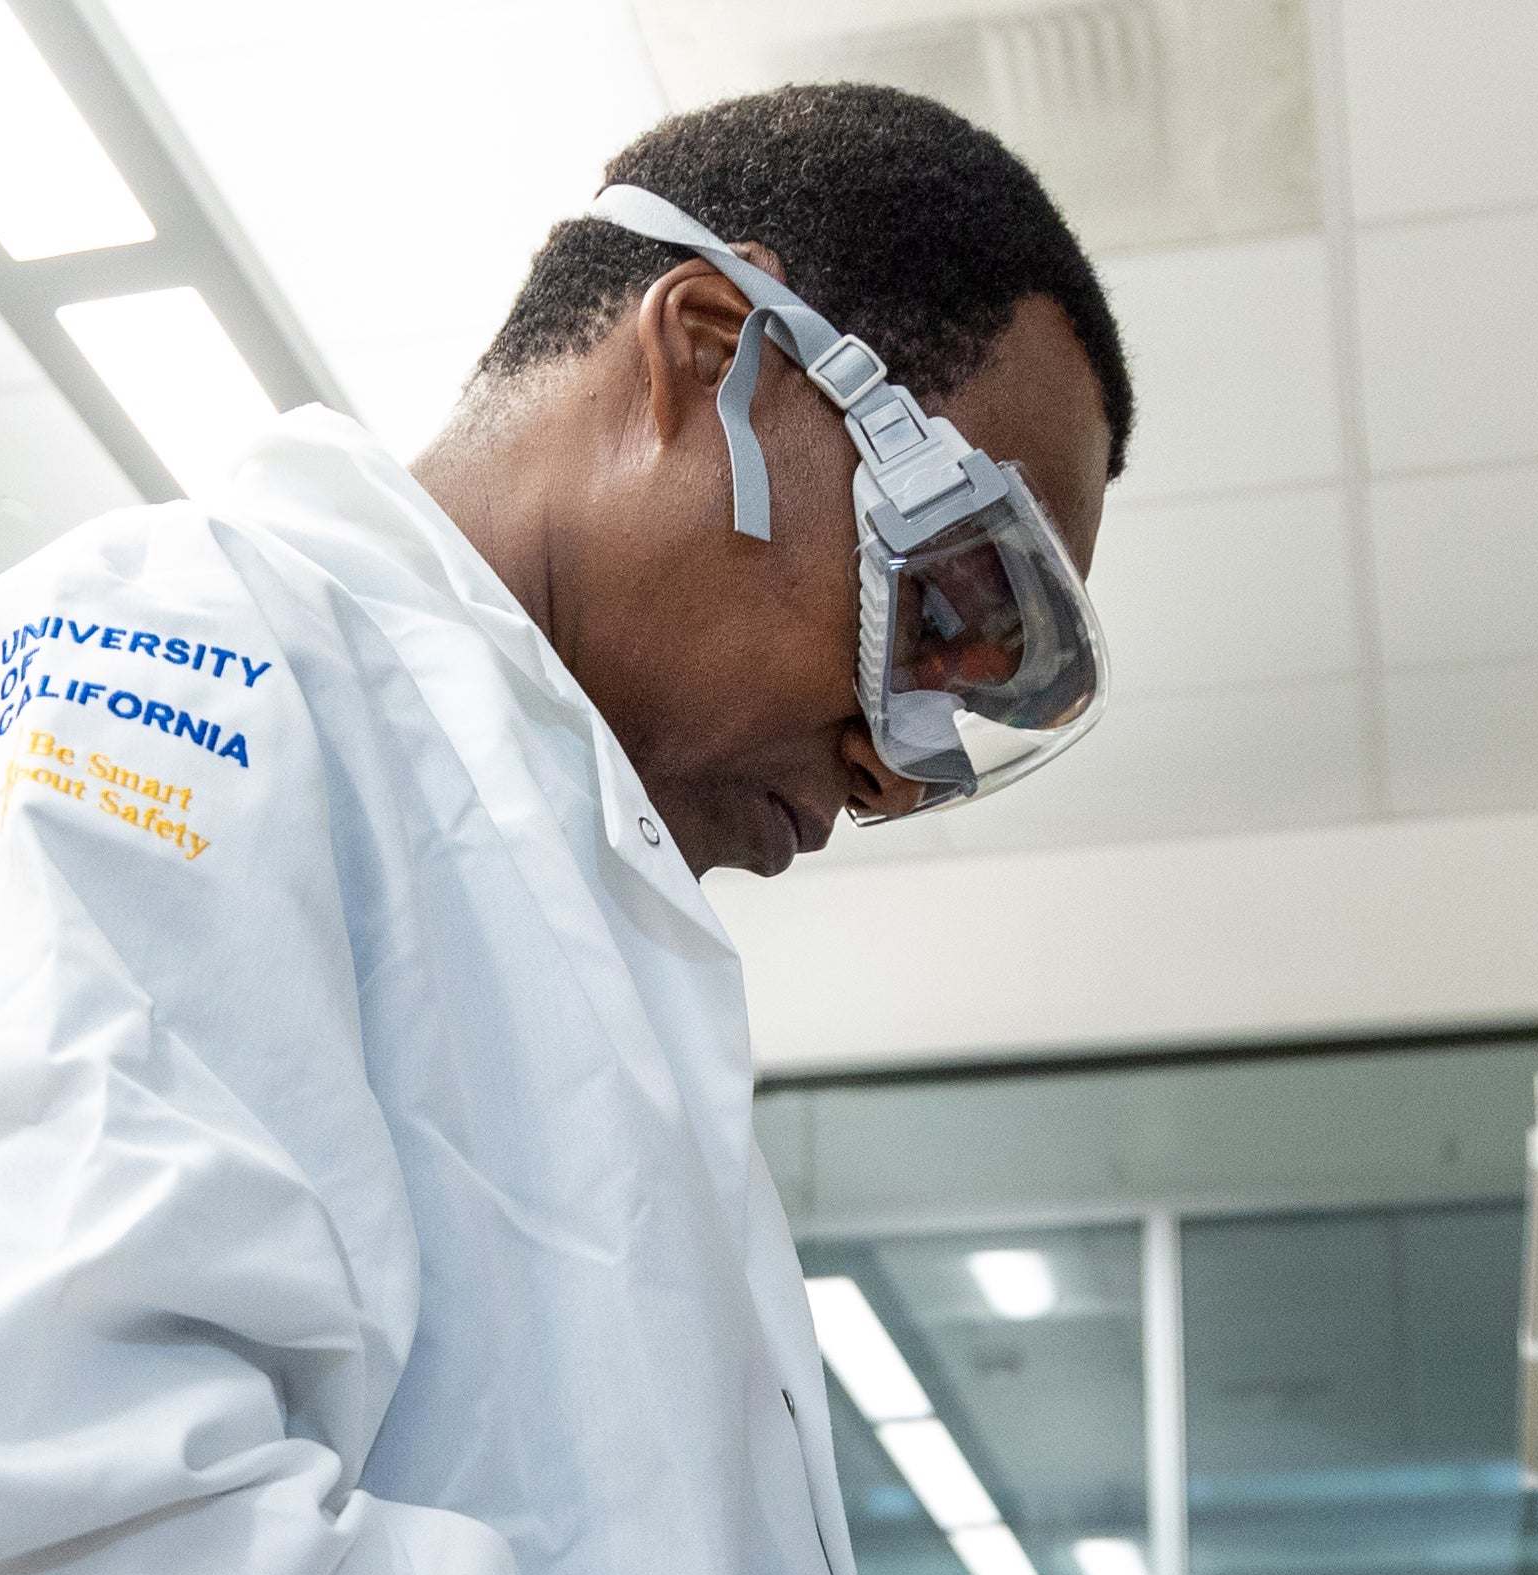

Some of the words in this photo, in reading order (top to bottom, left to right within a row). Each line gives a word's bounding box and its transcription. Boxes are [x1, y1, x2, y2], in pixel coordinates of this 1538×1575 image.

[0, 646, 41, 699] OF
[1, 615, 273, 688] UNIVERSITY
[27, 729, 76, 767] Be
[86, 751, 194, 813] Smart
[98, 787, 212, 860] Safety
